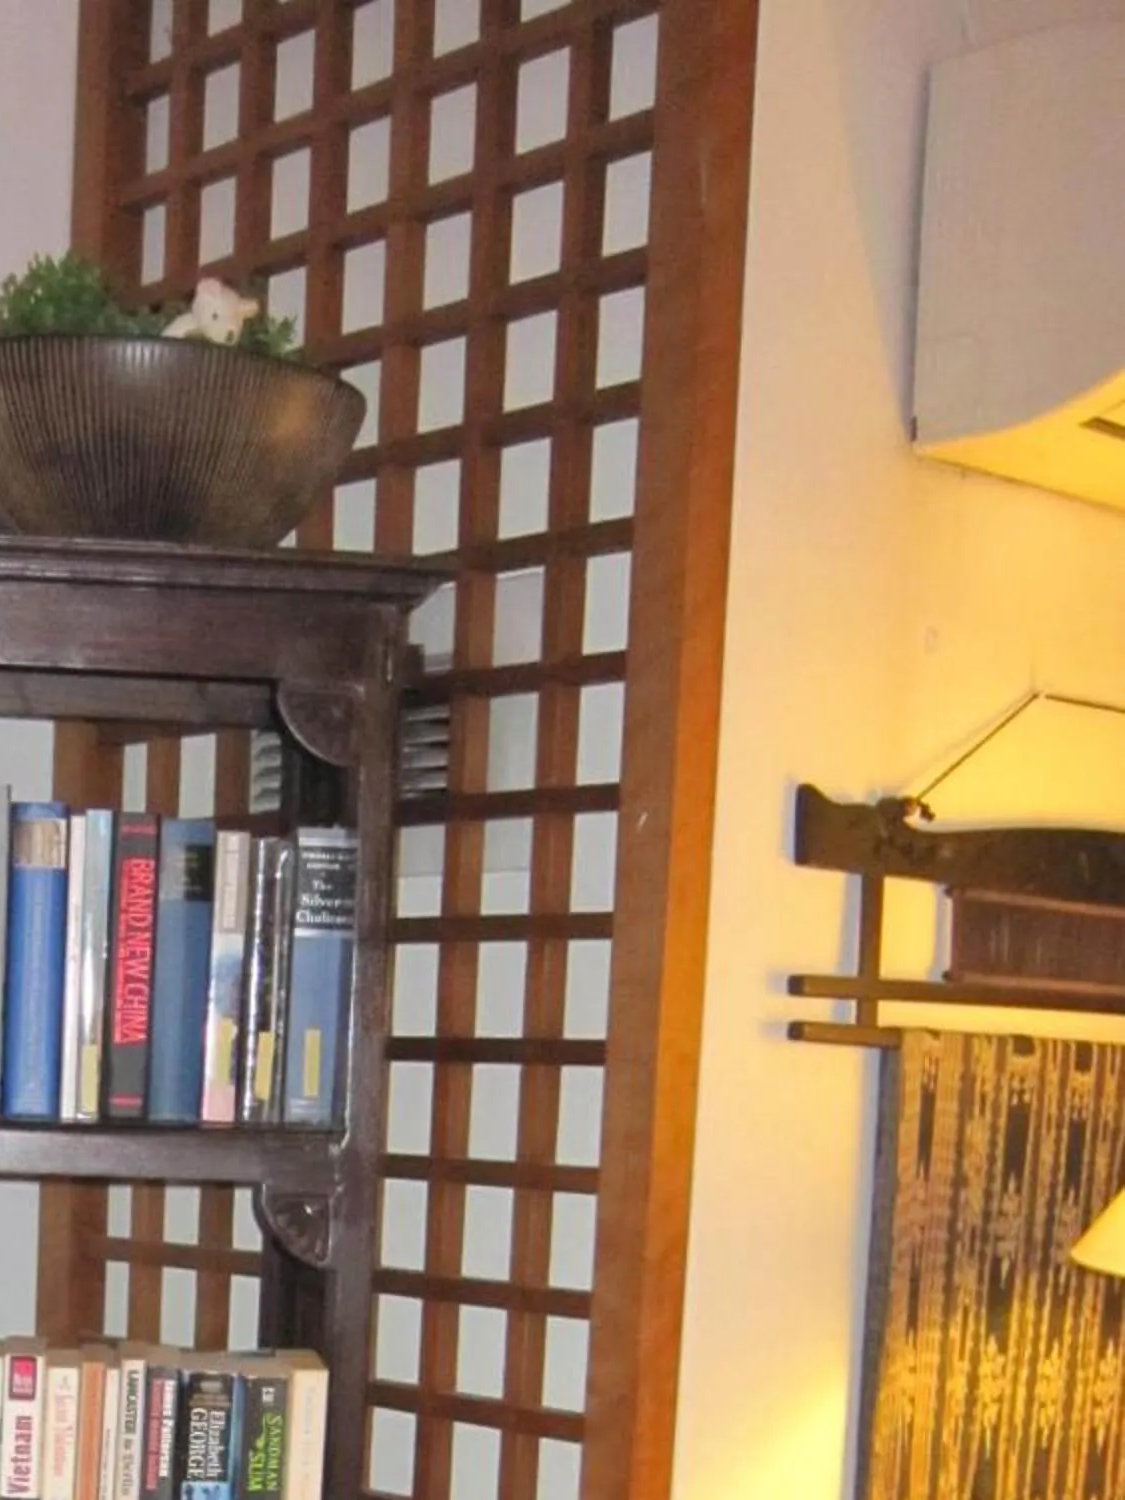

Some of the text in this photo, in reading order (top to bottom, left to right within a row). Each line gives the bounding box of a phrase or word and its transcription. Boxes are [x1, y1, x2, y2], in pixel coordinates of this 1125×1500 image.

[127, 860, 155, 927] BRAND
[124, 931, 152, 979] NEW
[121, 983, 148, 1043] CHINA
[124, 1370, 140, 1435] LANCASTER
[7, 1416, 33, 1494] Vietnam
[186, 1408, 208, 1479] GEORGE
[206, 1411, 227, 1479] Elizabeth
[263, 1412, 282, 1491] SANDMAN
